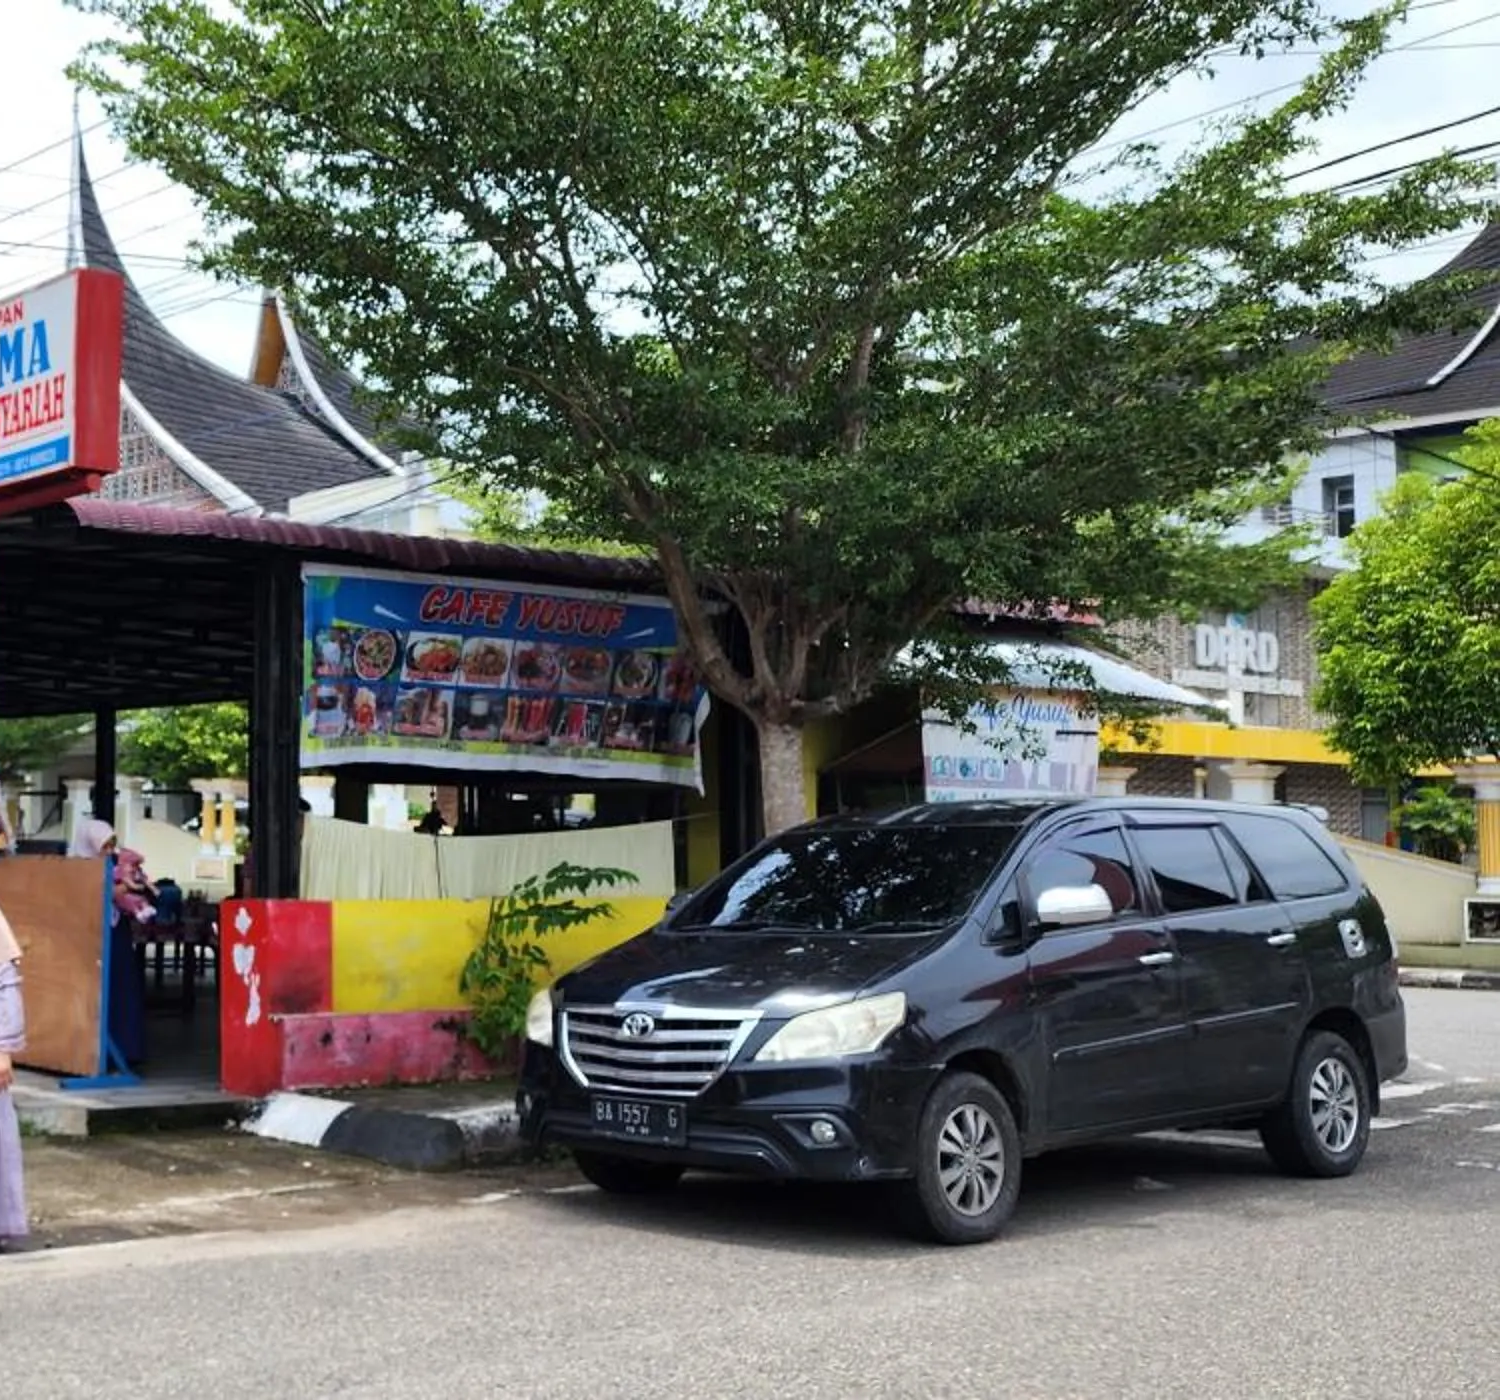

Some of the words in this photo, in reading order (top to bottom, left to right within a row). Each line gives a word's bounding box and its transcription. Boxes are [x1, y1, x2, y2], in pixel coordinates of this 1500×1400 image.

[418, 585, 511, 627] CAFE
[516, 595, 625, 638] YUSUF
[596, 1101, 613, 1121] BA
[618, 1103, 650, 1125] 1557
[667, 1107, 678, 1129] G
